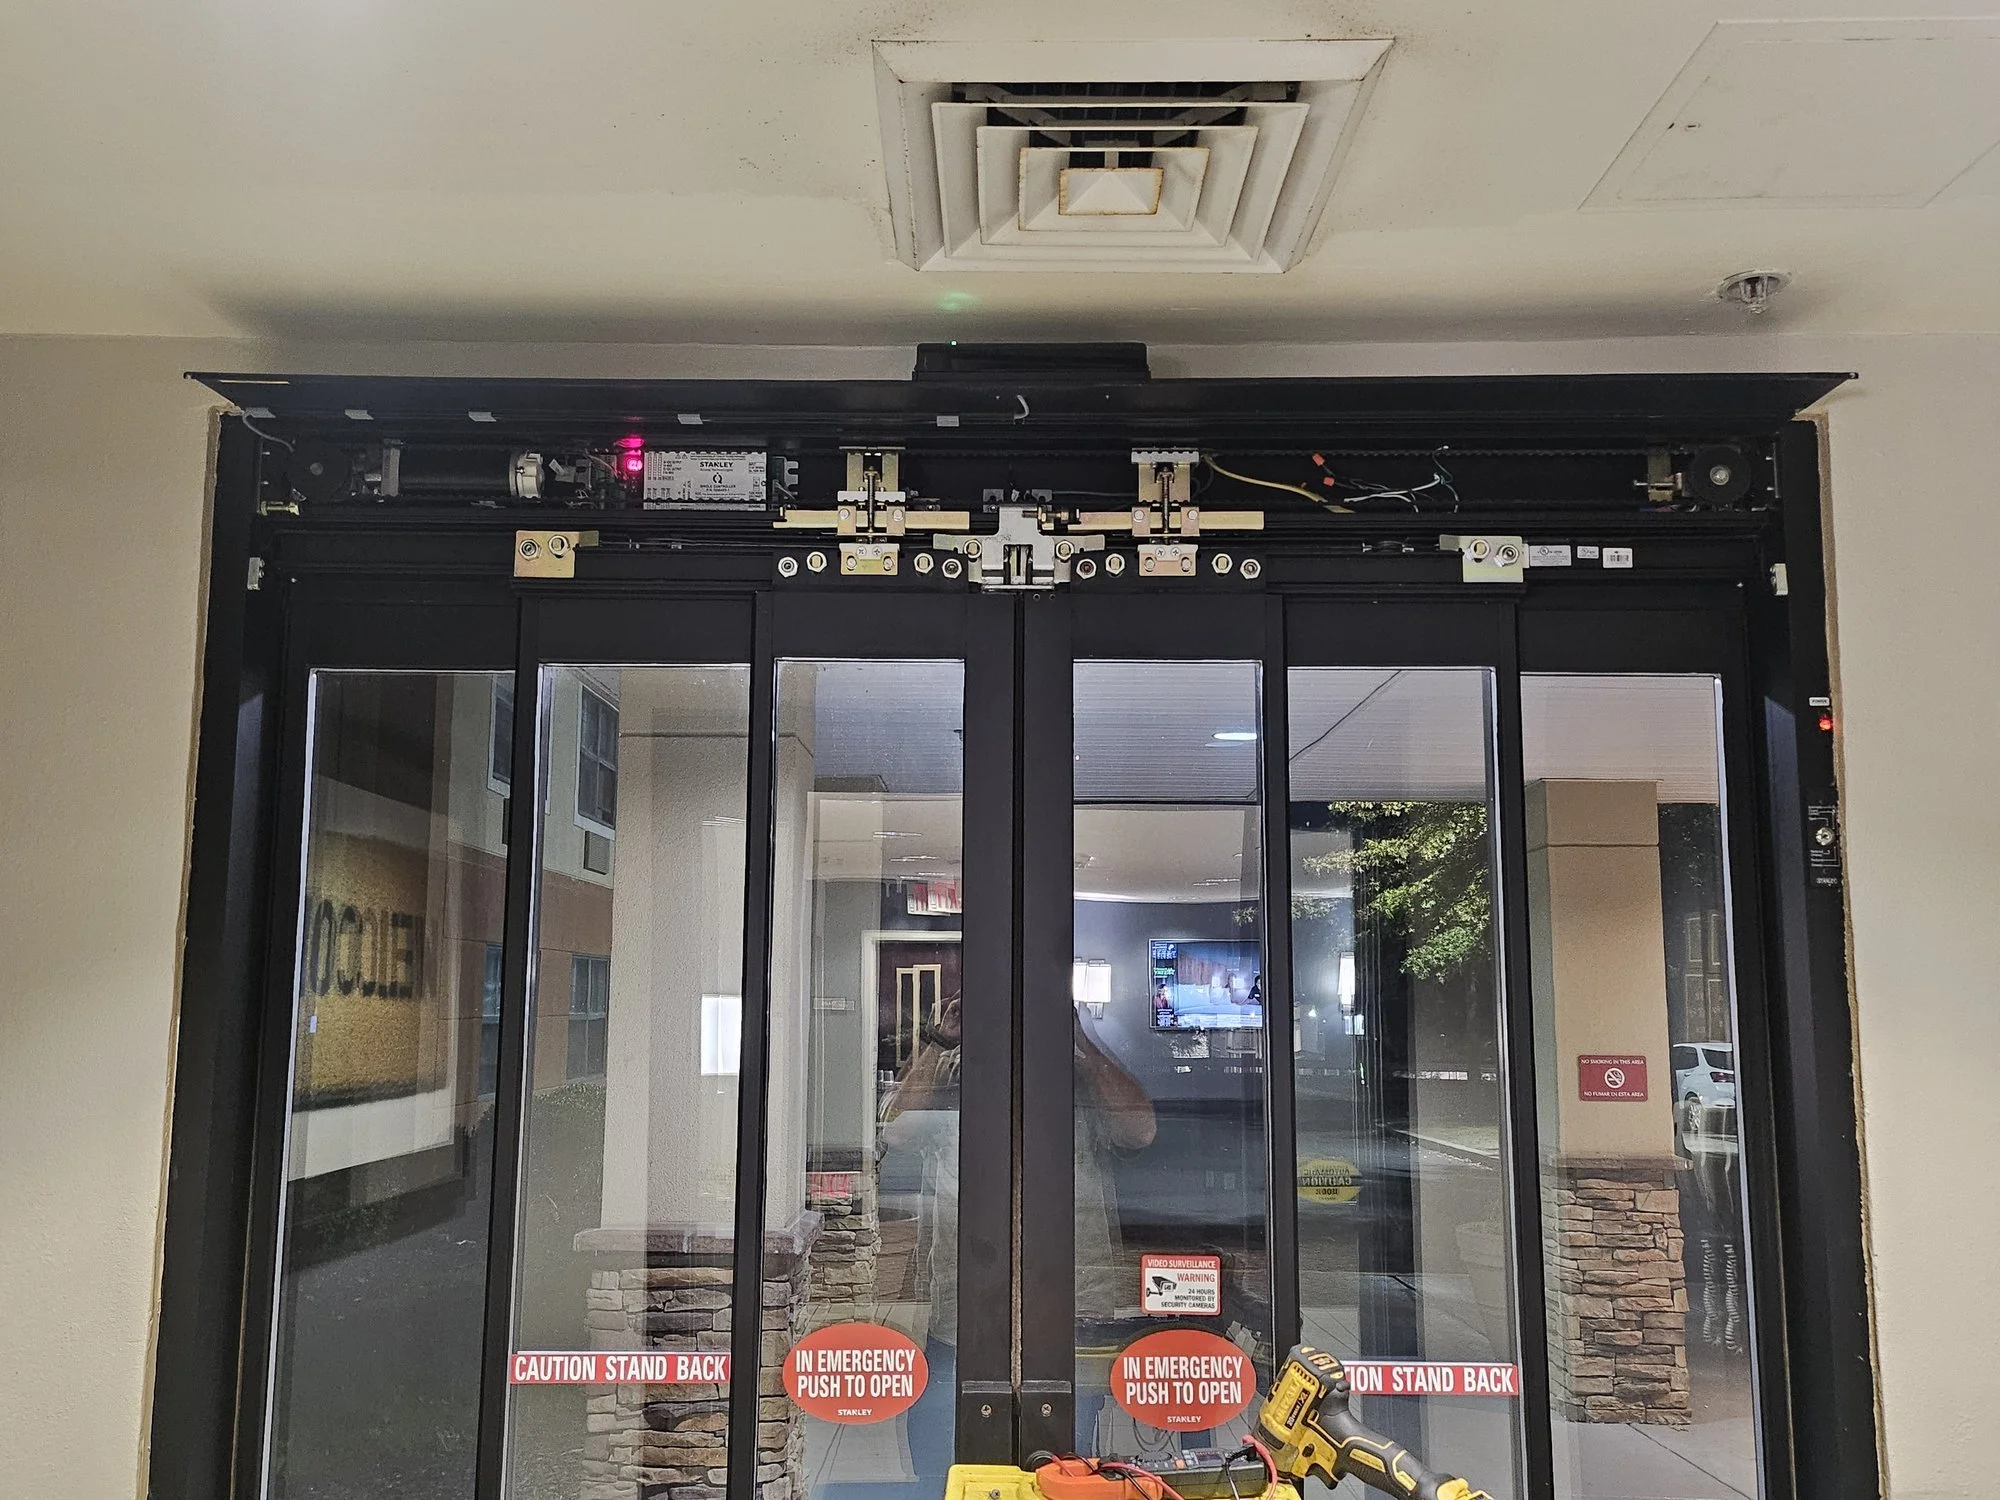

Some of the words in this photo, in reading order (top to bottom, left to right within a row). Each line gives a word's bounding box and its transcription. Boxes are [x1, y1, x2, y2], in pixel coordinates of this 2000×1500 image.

[1147, 1259, 1168, 1268] VIDEO
[1169, 1259, 1216, 1269] SURVEILLANCE
[1177, 1273, 1216, 1282] WARNING
[515, 1356, 596, 1381] CAUTION
[605, 1356, 667, 1381] STAND
[677, 1356, 727, 1381] BACK
[796, 1350, 813, 1373] IN
[818, 1349, 916, 1373] EMERGENCY
[1123, 1357, 1140, 1380] IN
[1145, 1355, 1243, 1379] EMERGENCY
[797, 1374, 840, 1398] PUSH
[845, 1374, 866, 1398] TO
[870, 1374, 913, 1398] OPEN
[1392, 1366, 1455, 1393] STAND
[1463, 1366, 1515, 1393] BACK
[1126, 1381, 1169, 1405] PUSH
[1173, 1381, 1194, 1404] TO
[1198, 1381, 1242, 1405] OPEN
[1167, 1415, 1202, 1423] STANLEY
